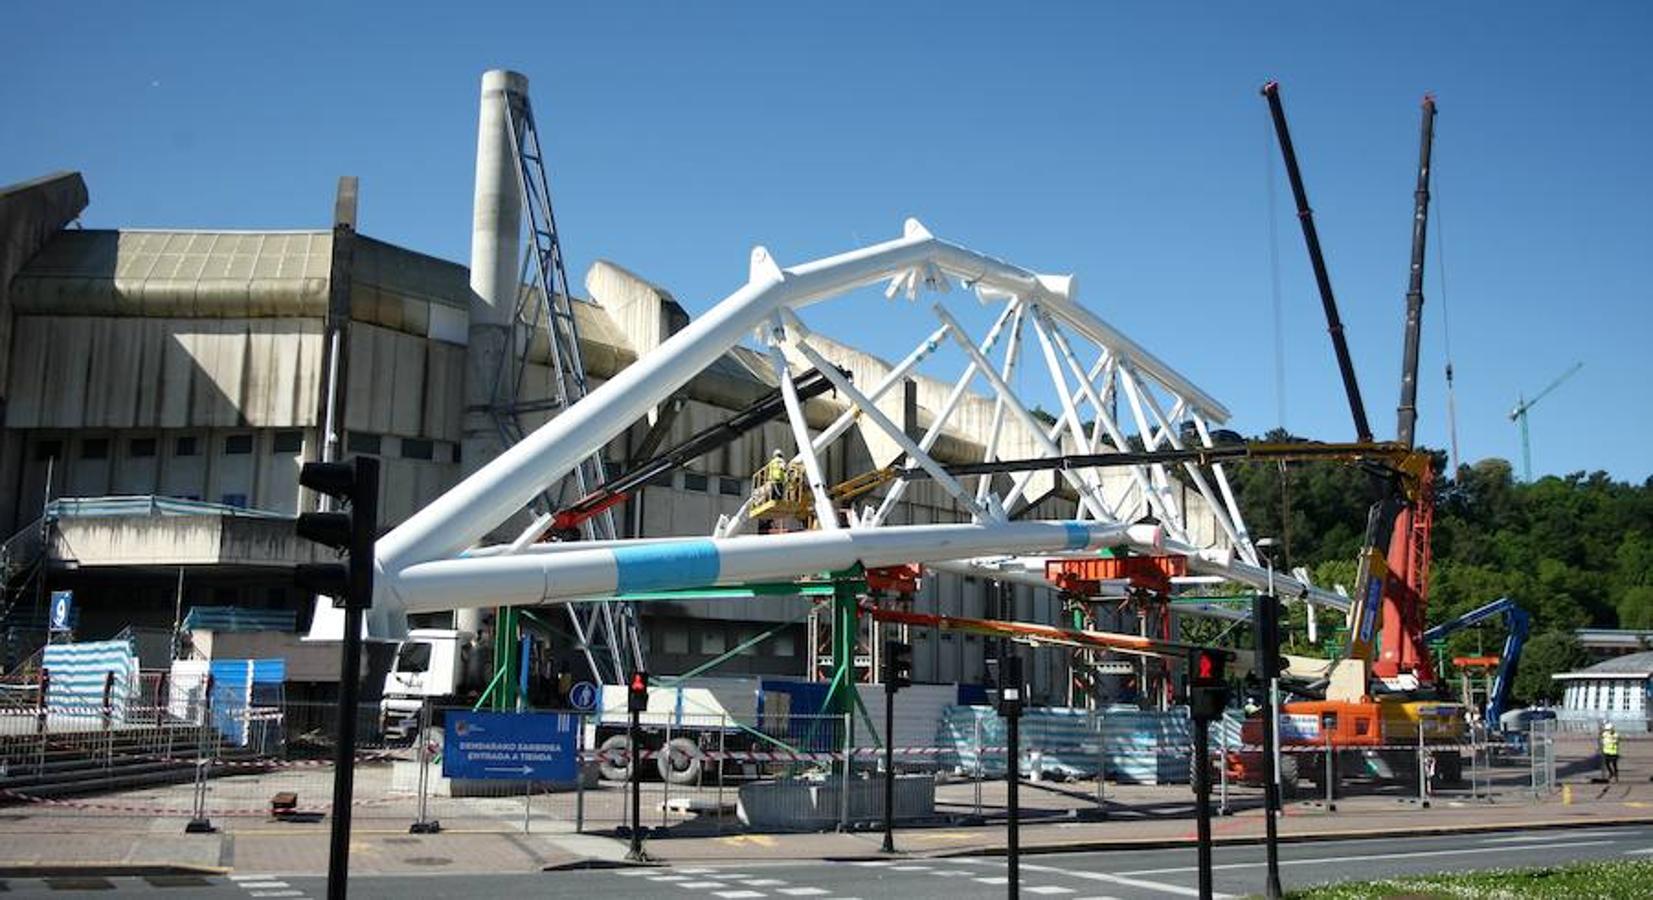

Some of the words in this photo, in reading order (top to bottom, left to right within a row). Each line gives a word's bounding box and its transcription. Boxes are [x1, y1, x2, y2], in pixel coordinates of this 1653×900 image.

[53, 598, 65, 627] 9
[467, 752, 511, 761] ENTRADA
[520, 753, 552, 762] TIENDA
